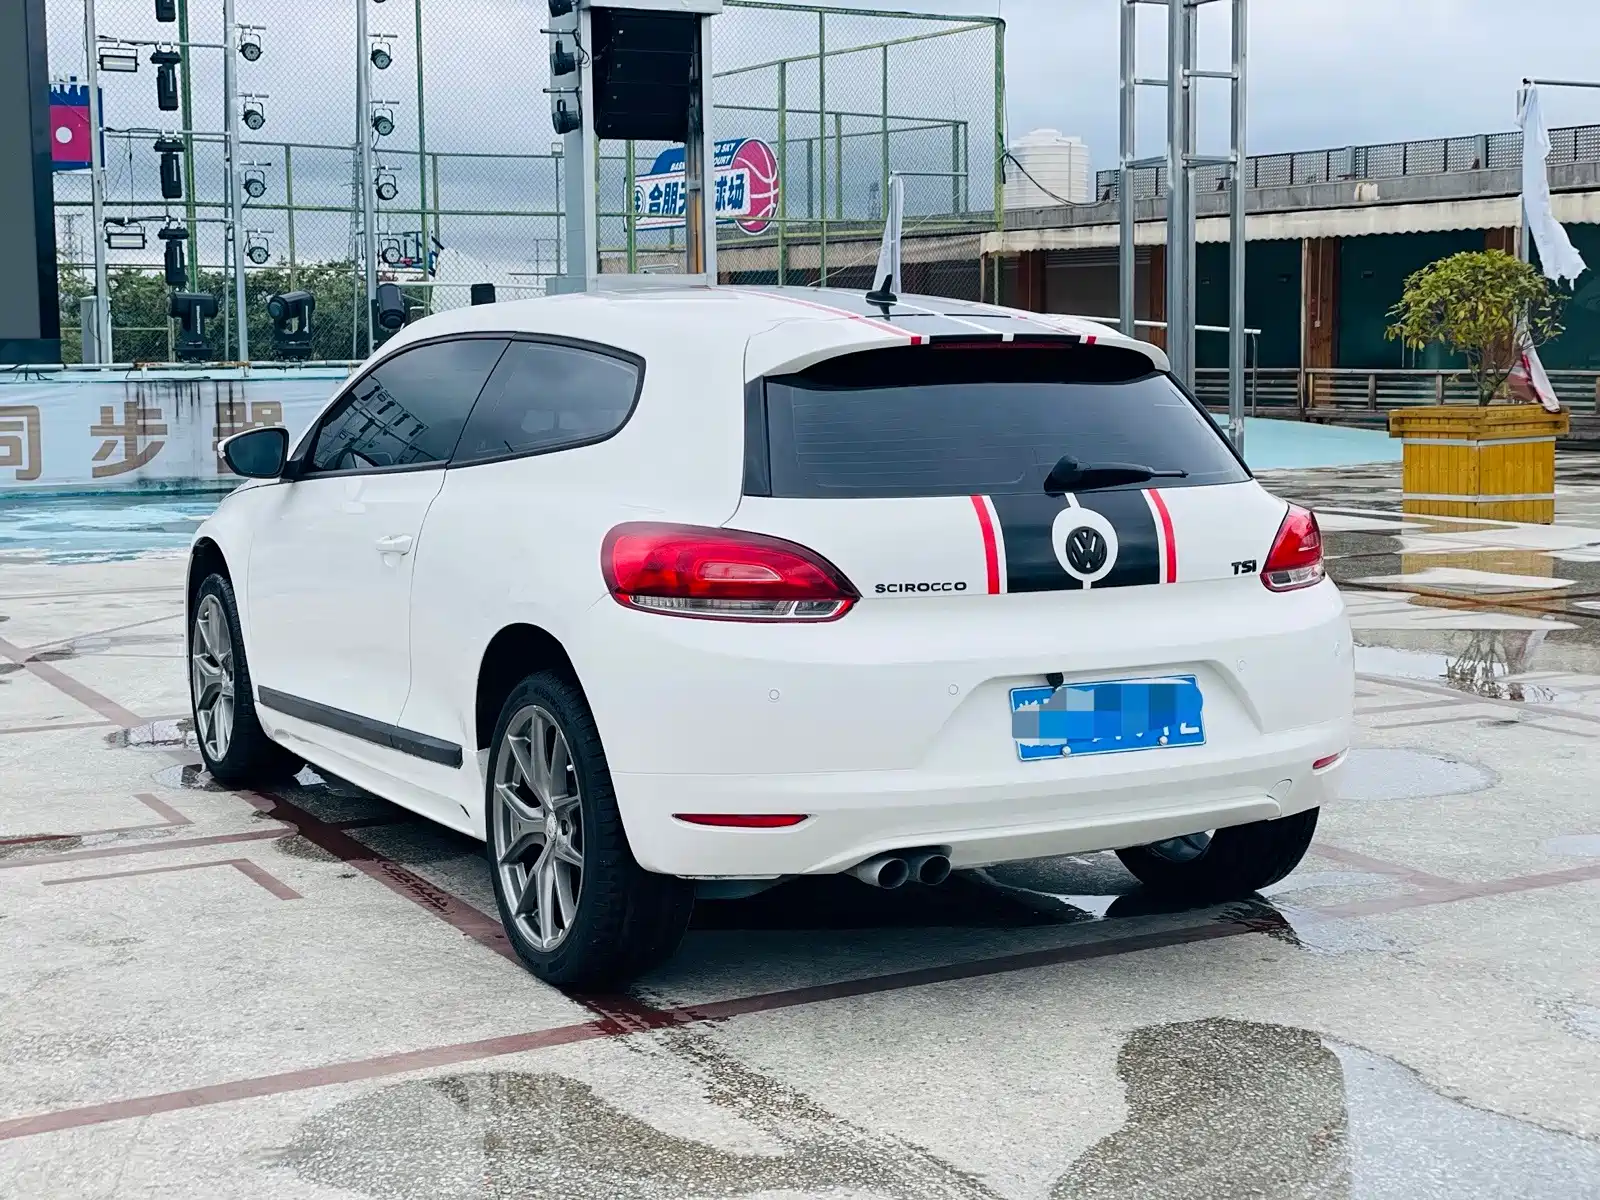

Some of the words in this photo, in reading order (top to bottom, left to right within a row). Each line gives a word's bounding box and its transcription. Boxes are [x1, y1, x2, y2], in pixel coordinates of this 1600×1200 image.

[721, 142, 736, 153] SKY
[714, 155, 731, 166] OURT
[1231, 559, 1257, 575] TSI
[874, 581, 967, 594] SCIROCCO
